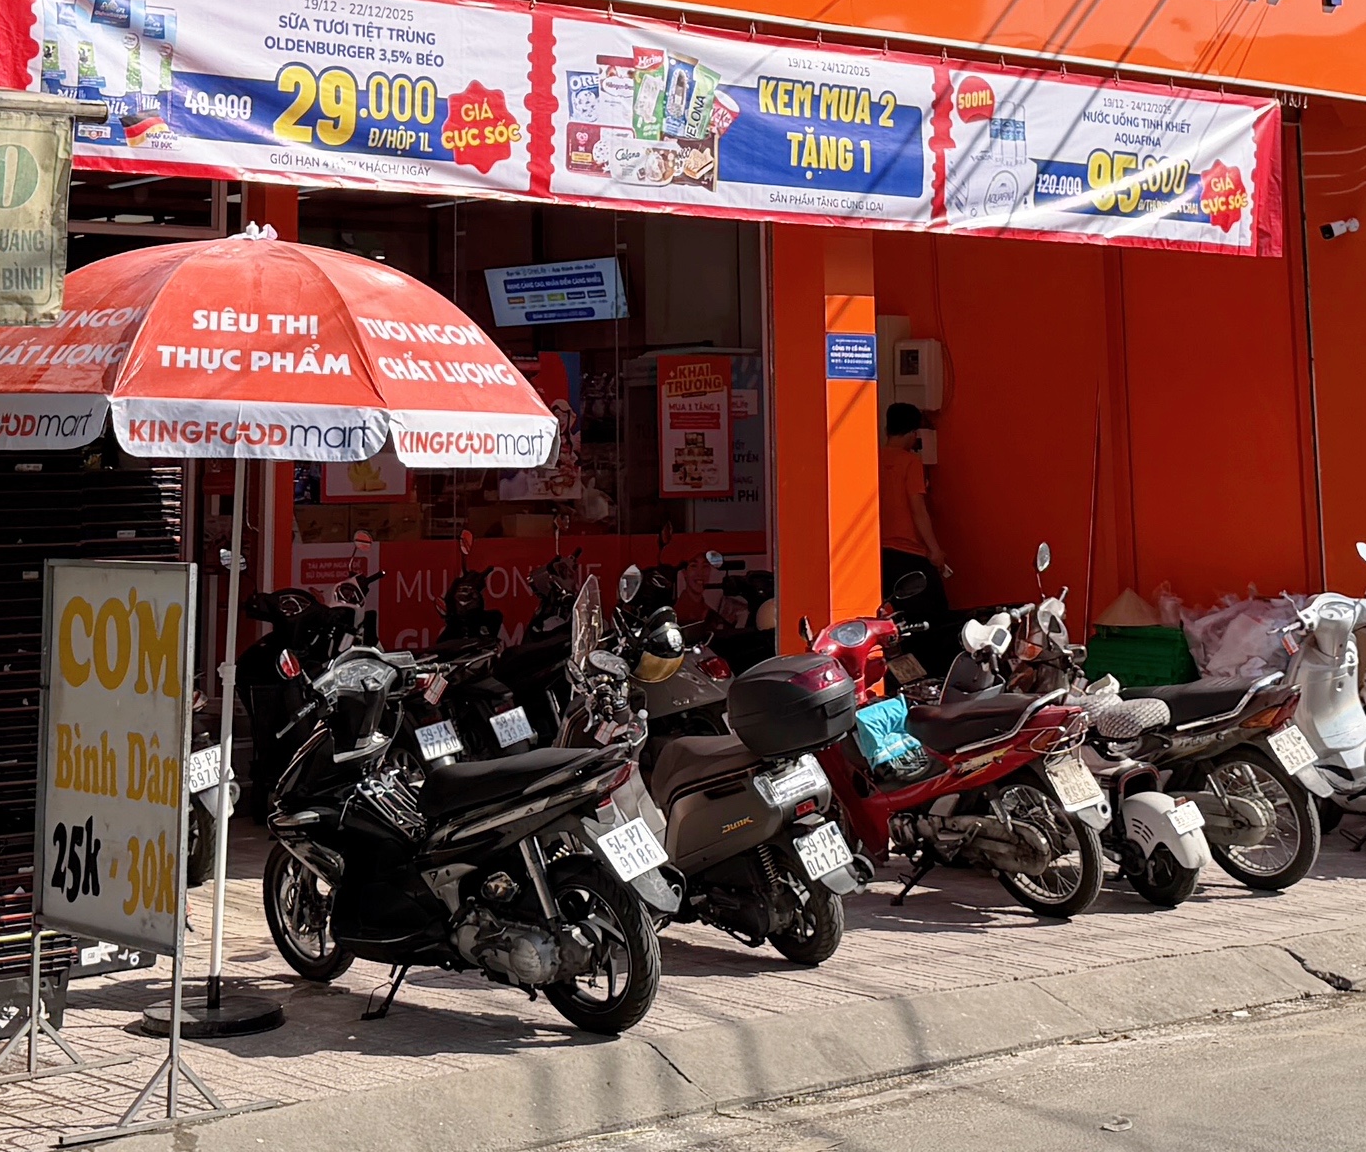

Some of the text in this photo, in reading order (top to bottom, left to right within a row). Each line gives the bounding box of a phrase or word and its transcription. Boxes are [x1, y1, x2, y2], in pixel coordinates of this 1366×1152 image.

[349, 2, 414, 22] 22/12/2025
[278, 12, 436, 46] SỮA TƯƠI TIỆT TRÙNG
[264, 35, 445, 68] OLDENBURGER 3,5% BÉO
[569, 74, 599, 91] ORE
[272, 63, 436, 147] 29.000
[460, 98, 494, 122] GIÁ
[685, 94, 706, 139] ELONA
[758, 77, 897, 128] KEM MUA 2
[441, 119, 523, 153] CỰC SỐC
[786, 125, 871, 180] TẶNG 1
[1210, 177, 1235, 192] GIÁ
[1200, 197, 1227, 216] CỰC
[9, 264, 46, 292] BÌNH
[191, 307, 320, 340] SIÊU THỊ
[356, 316, 486, 346] TƯƠI NGON
[155, 341, 353, 377] THỰC PHẨM
[397, 567, 448, 603] MU
[58, 586, 183, 699] CƠM
[126, 730, 179, 808] Dân
[190, 766, 221, 790] 697.0
